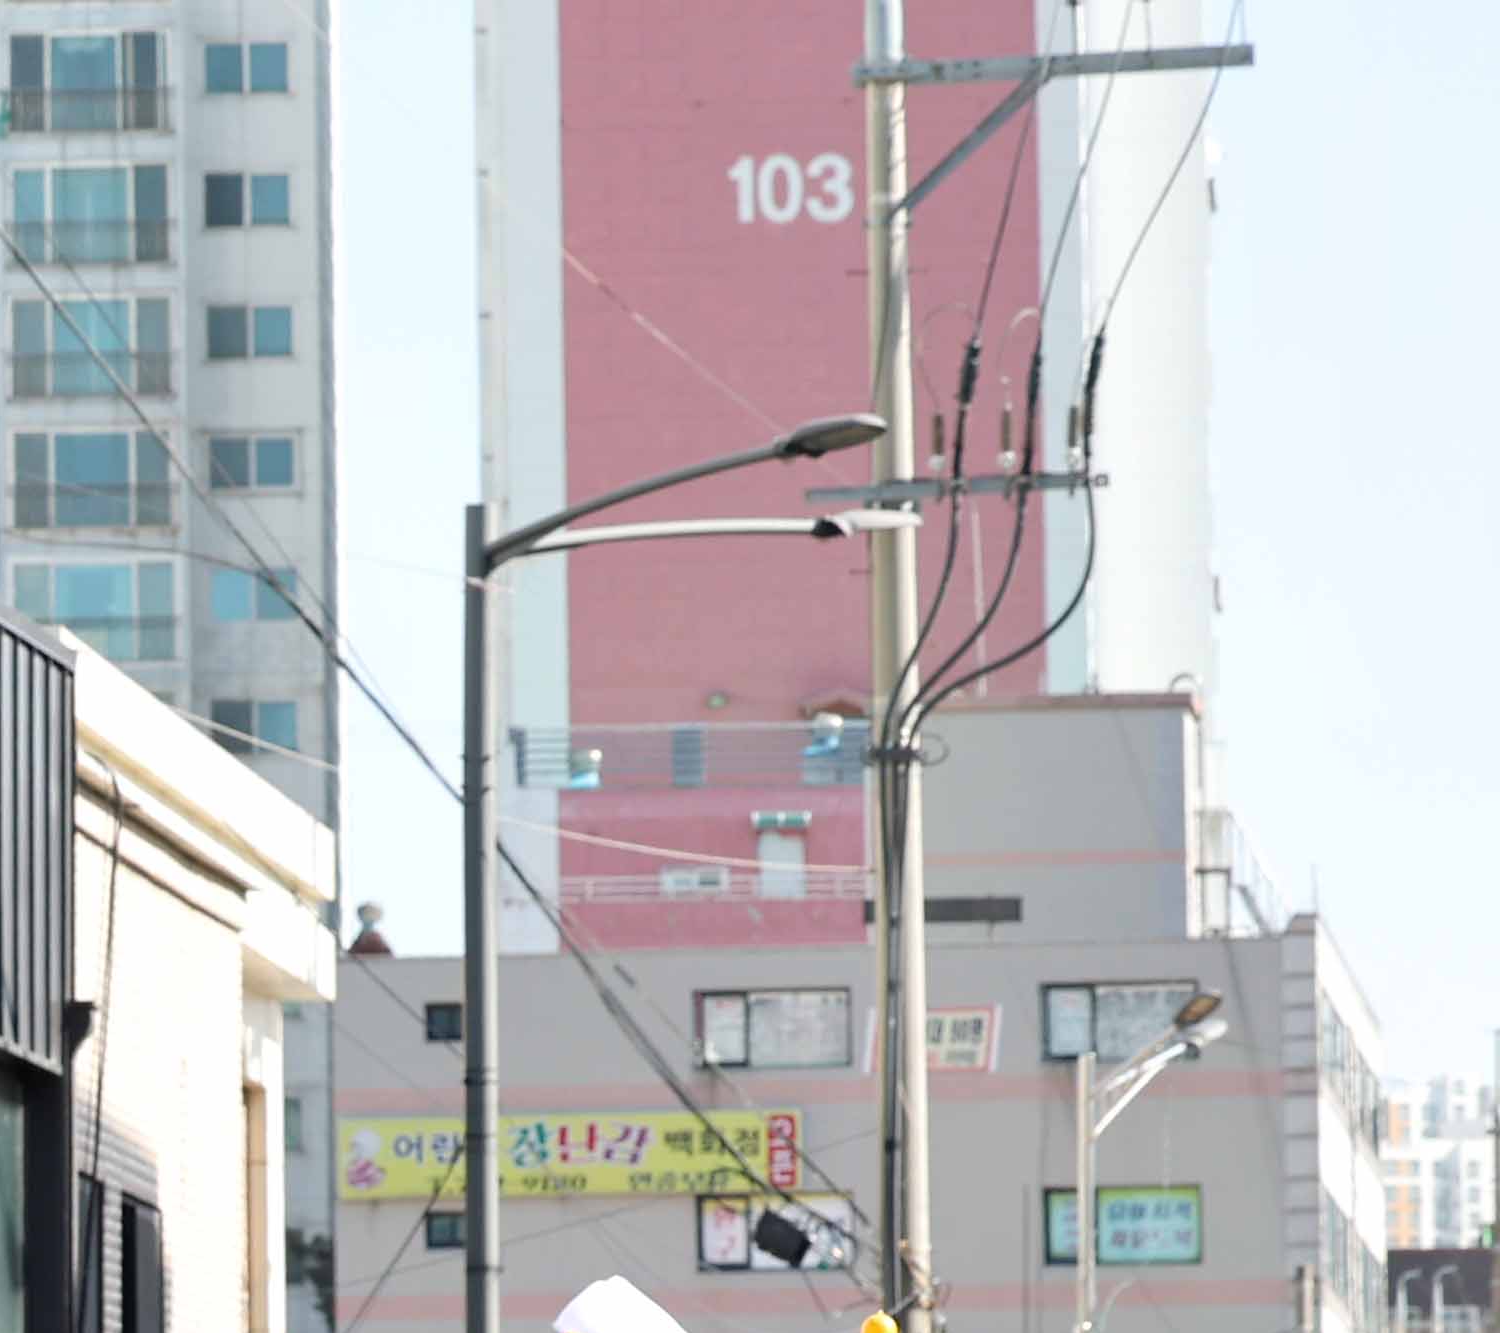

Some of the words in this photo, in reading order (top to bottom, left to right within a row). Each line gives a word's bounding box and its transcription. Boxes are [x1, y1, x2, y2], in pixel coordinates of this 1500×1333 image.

[727, 154, 854, 223] 103
[393, 1128, 466, 1165] 어린
[509, 1121, 653, 1168] 장난감
